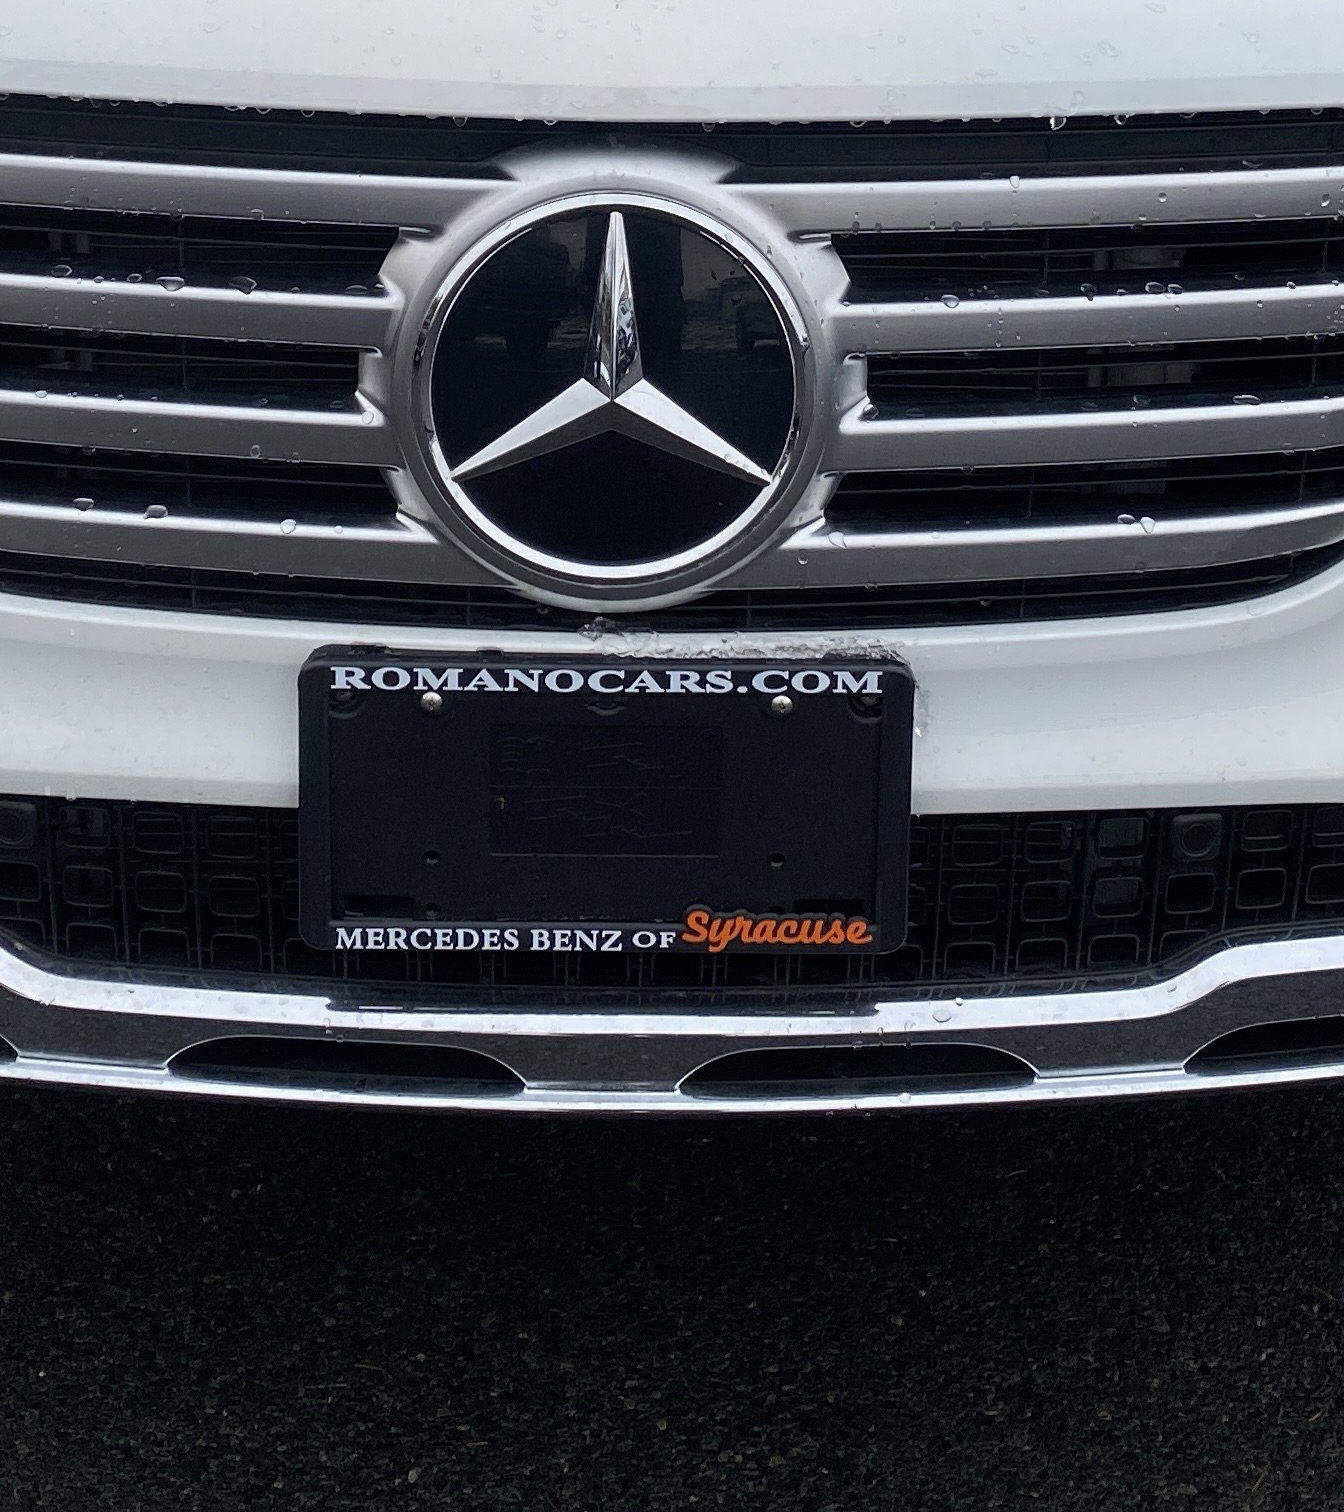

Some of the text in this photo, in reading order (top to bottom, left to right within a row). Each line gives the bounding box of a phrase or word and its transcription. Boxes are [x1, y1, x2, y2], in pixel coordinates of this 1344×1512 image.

[330, 665, 884, 694] ROMANOCARS.COM
[334, 907, 874, 953] MERCEDES BENZ OF Syracuse
